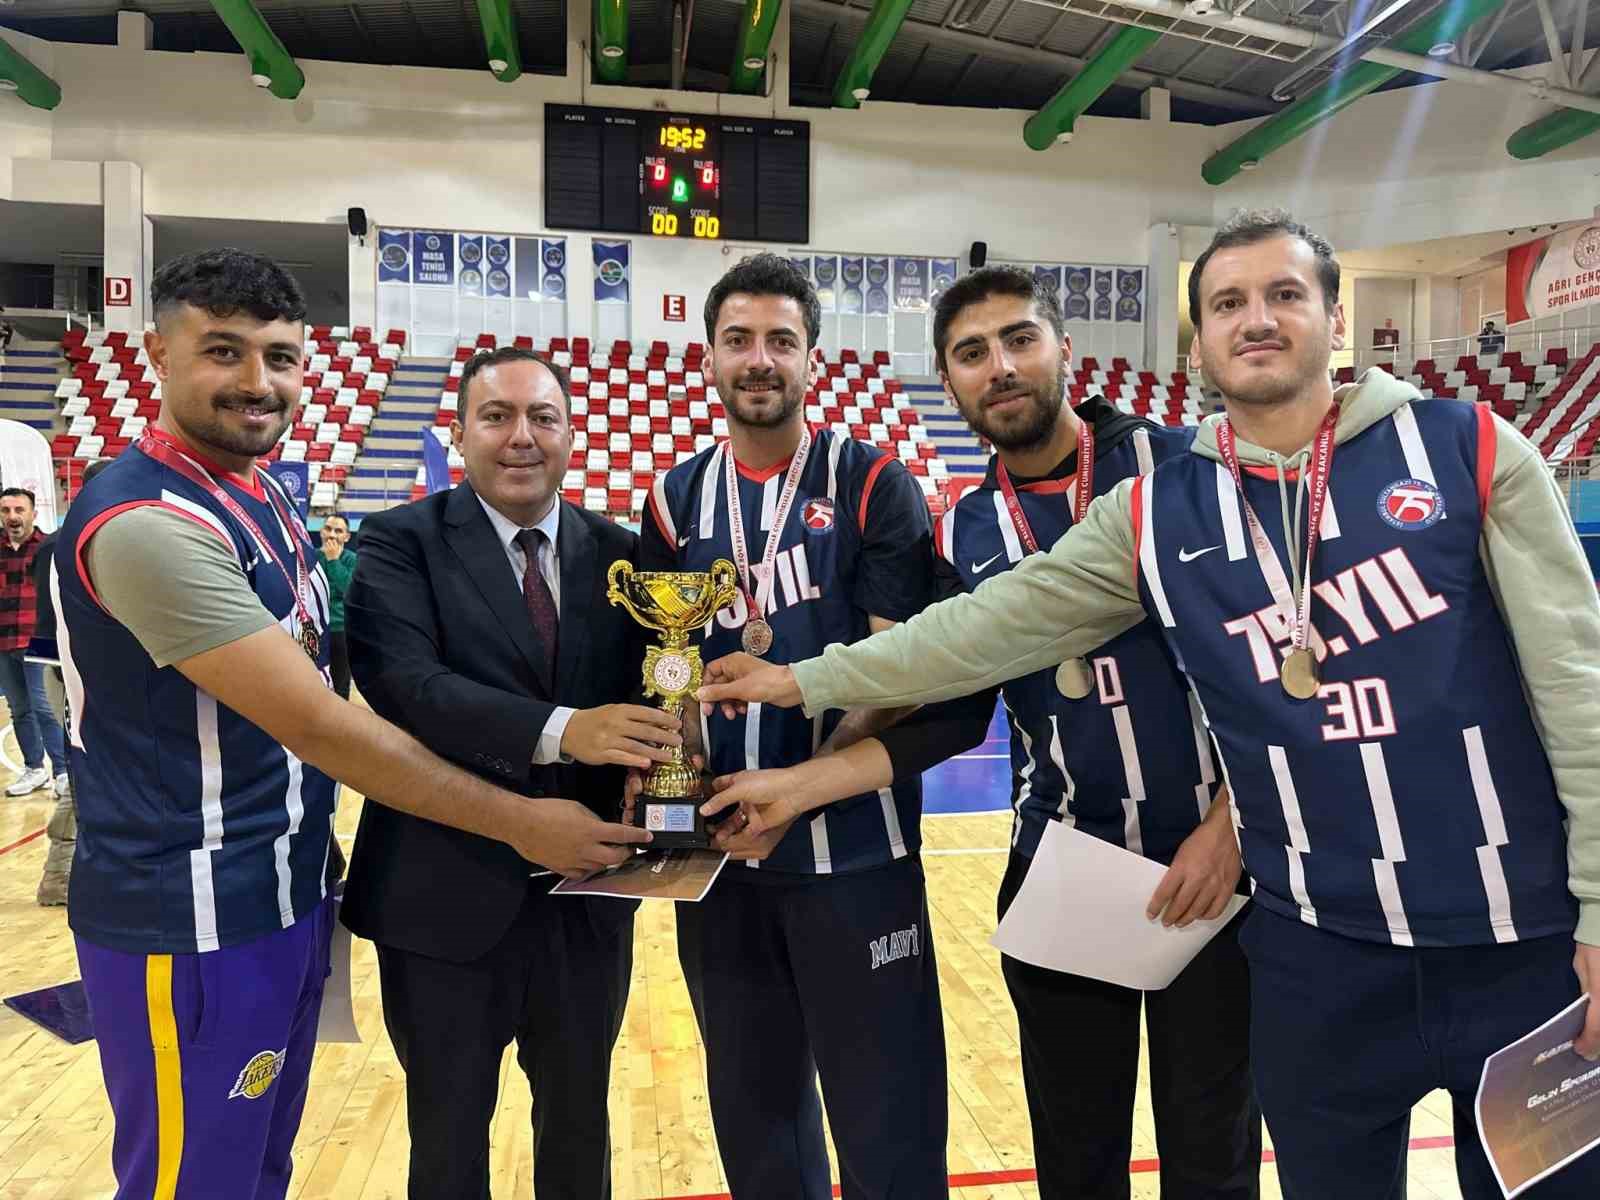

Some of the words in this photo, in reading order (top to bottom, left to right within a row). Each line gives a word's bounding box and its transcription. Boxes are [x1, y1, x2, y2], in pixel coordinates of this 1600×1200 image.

[660, 127, 706, 149] 19:52
[654, 165, 666, 180] 0
[703, 168, 713, 183] 0
[652, 214, 678, 235] 00
[694, 216, 719, 238] 00
[111, 279, 127, 299] D
[1547, 277, 1570, 293] AĞRI
[669, 296, 681, 315] E
[1548, 293, 1570, 308] SPOR
[1316, 677, 1397, 741] 30
[870, 924, 919, 969] MAVİ
